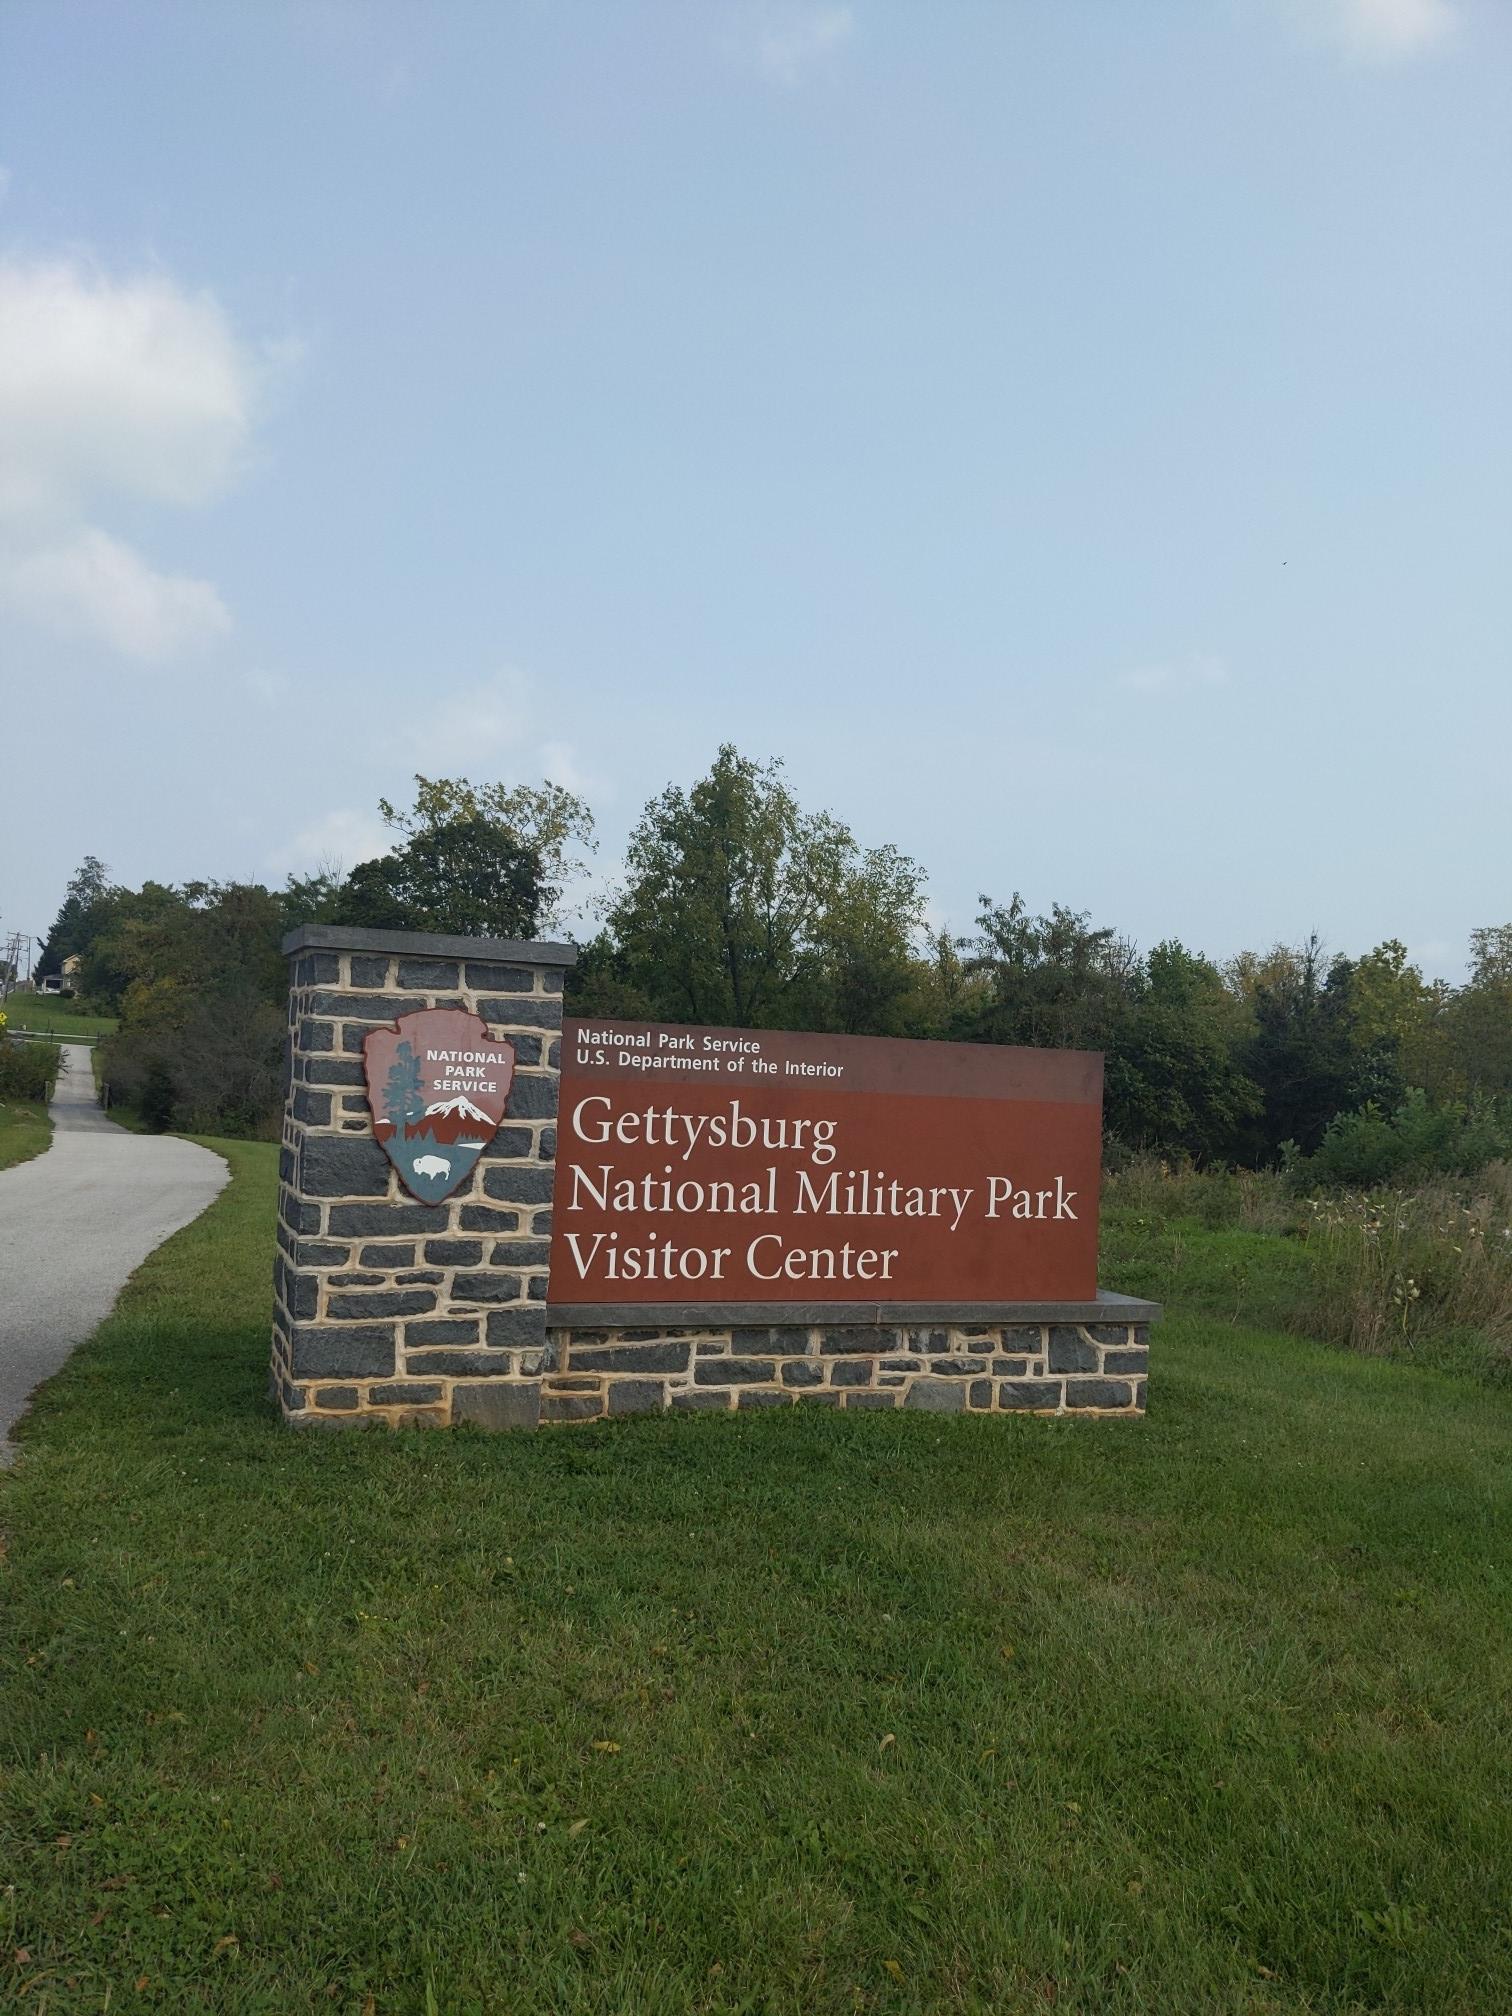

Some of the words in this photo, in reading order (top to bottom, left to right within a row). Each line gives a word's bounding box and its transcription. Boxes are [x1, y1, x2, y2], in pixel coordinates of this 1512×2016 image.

[577, 1029, 651, 1048] National
[659, 1033, 695, 1050] Park
[702, 1036, 761, 1054] Service
[427, 1050, 505, 1063] NATIONAL
[576, 1049, 611, 1066] U.S.
[618, 1051, 720, 1071] Department
[726, 1056, 744, 1073] of
[750, 1058, 778, 1074] the
[785, 1060, 844, 1078] Interior
[445, 1066, 485, 1077] PARK
[433, 1080, 496, 1092] SERVICE
[572, 1096, 838, 1165] Gettysburg
[567, 1164, 778, 1214] National
[793, 1169, 974, 1231] Military
[984, 1176, 1079, 1220] Park
[563, 1231, 732, 1280] Visitor
[746, 1234, 899, 1280] Center
